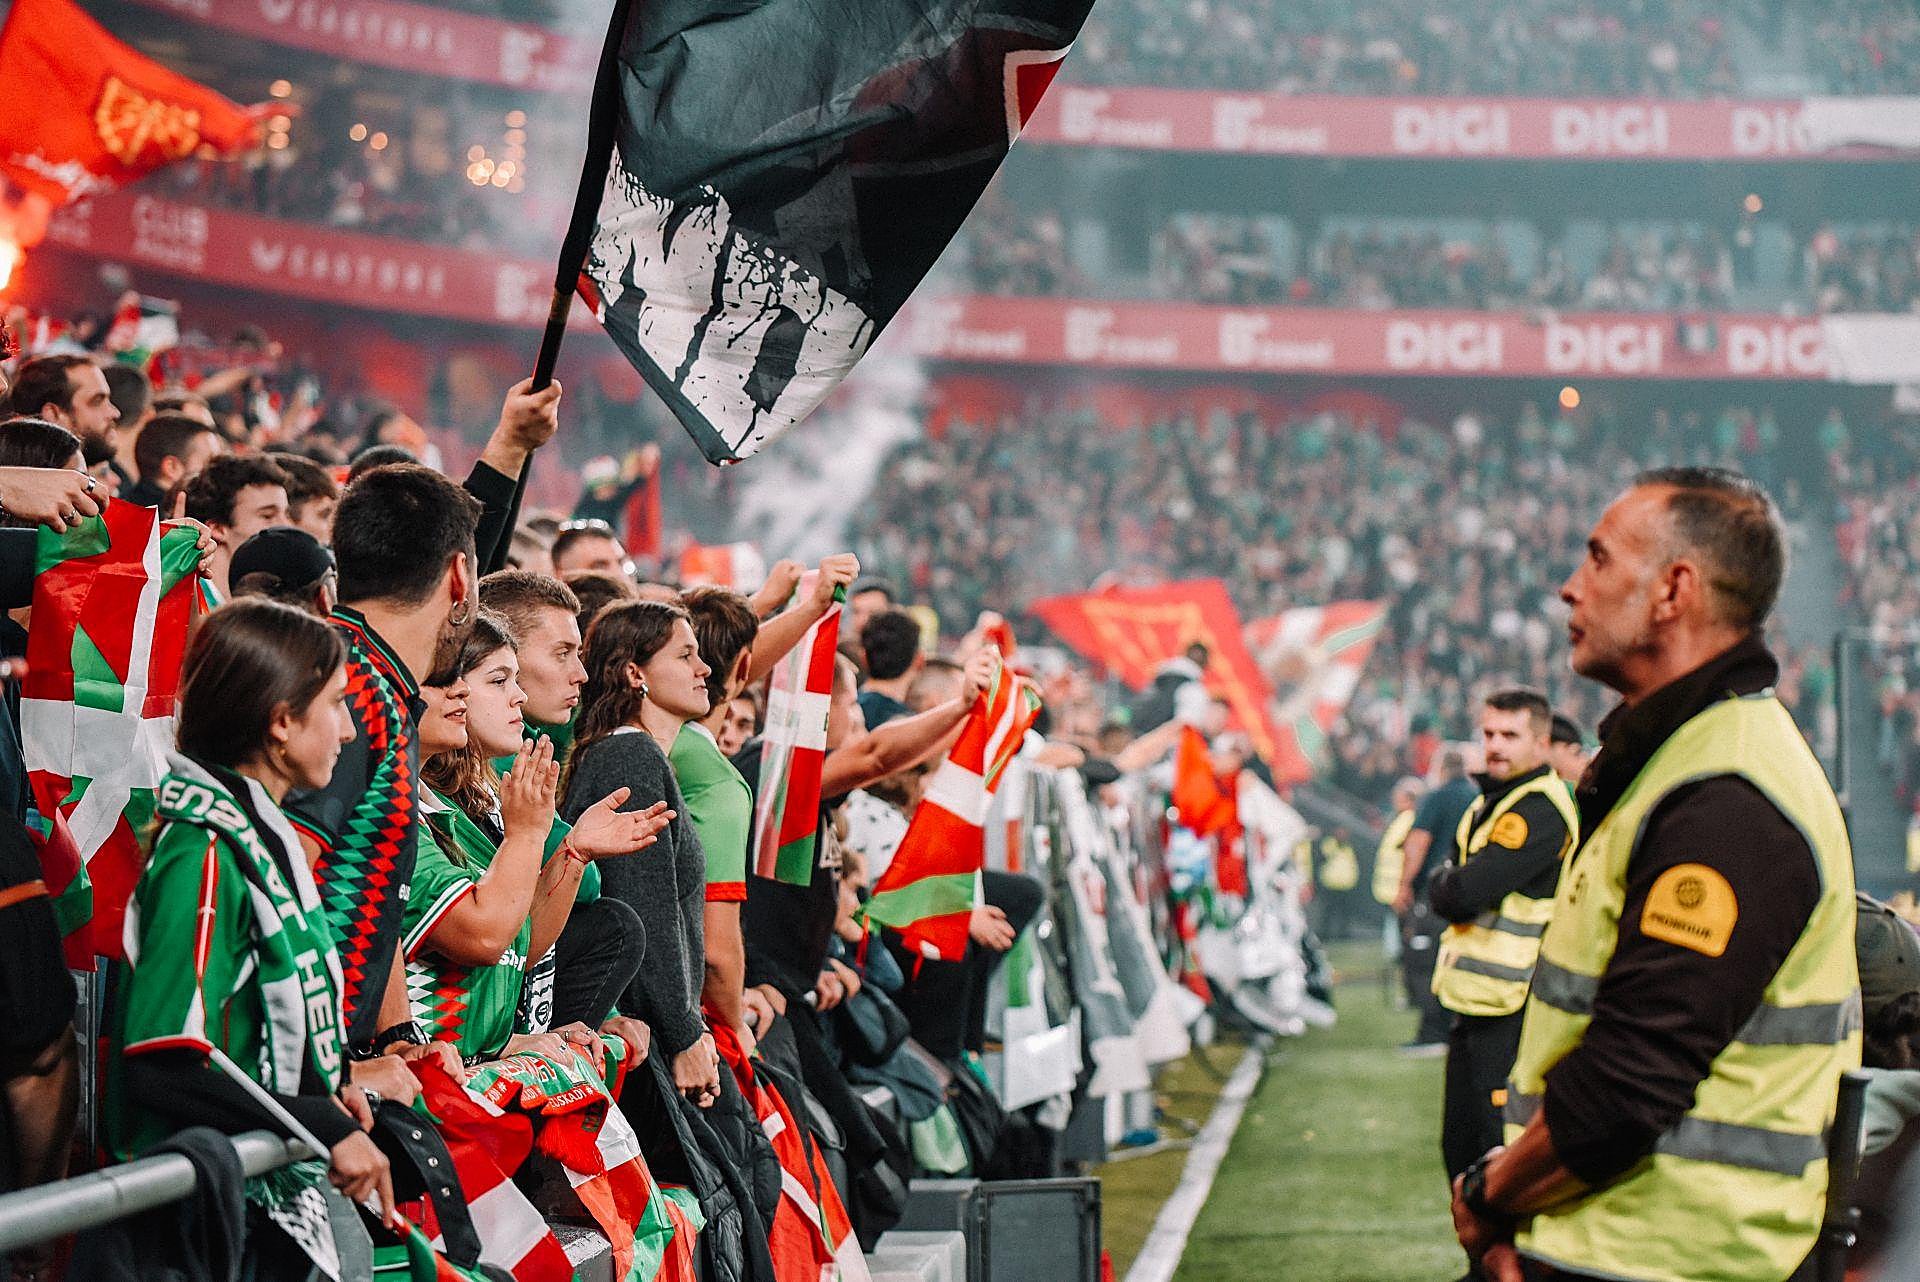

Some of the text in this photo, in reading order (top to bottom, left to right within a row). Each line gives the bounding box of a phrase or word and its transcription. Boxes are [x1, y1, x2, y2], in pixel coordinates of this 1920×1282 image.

[1393, 106, 1509, 152] DIGI
[1552, 107, 1669, 153] DIGI
[1732, 108, 1806, 153] DI
[1386, 319, 1502, 370] DIGI
[1545, 323, 1662, 373] DIGI
[1728, 324, 1830, 374] DIG
[549, 1088, 587, 1108] EUSKADI
